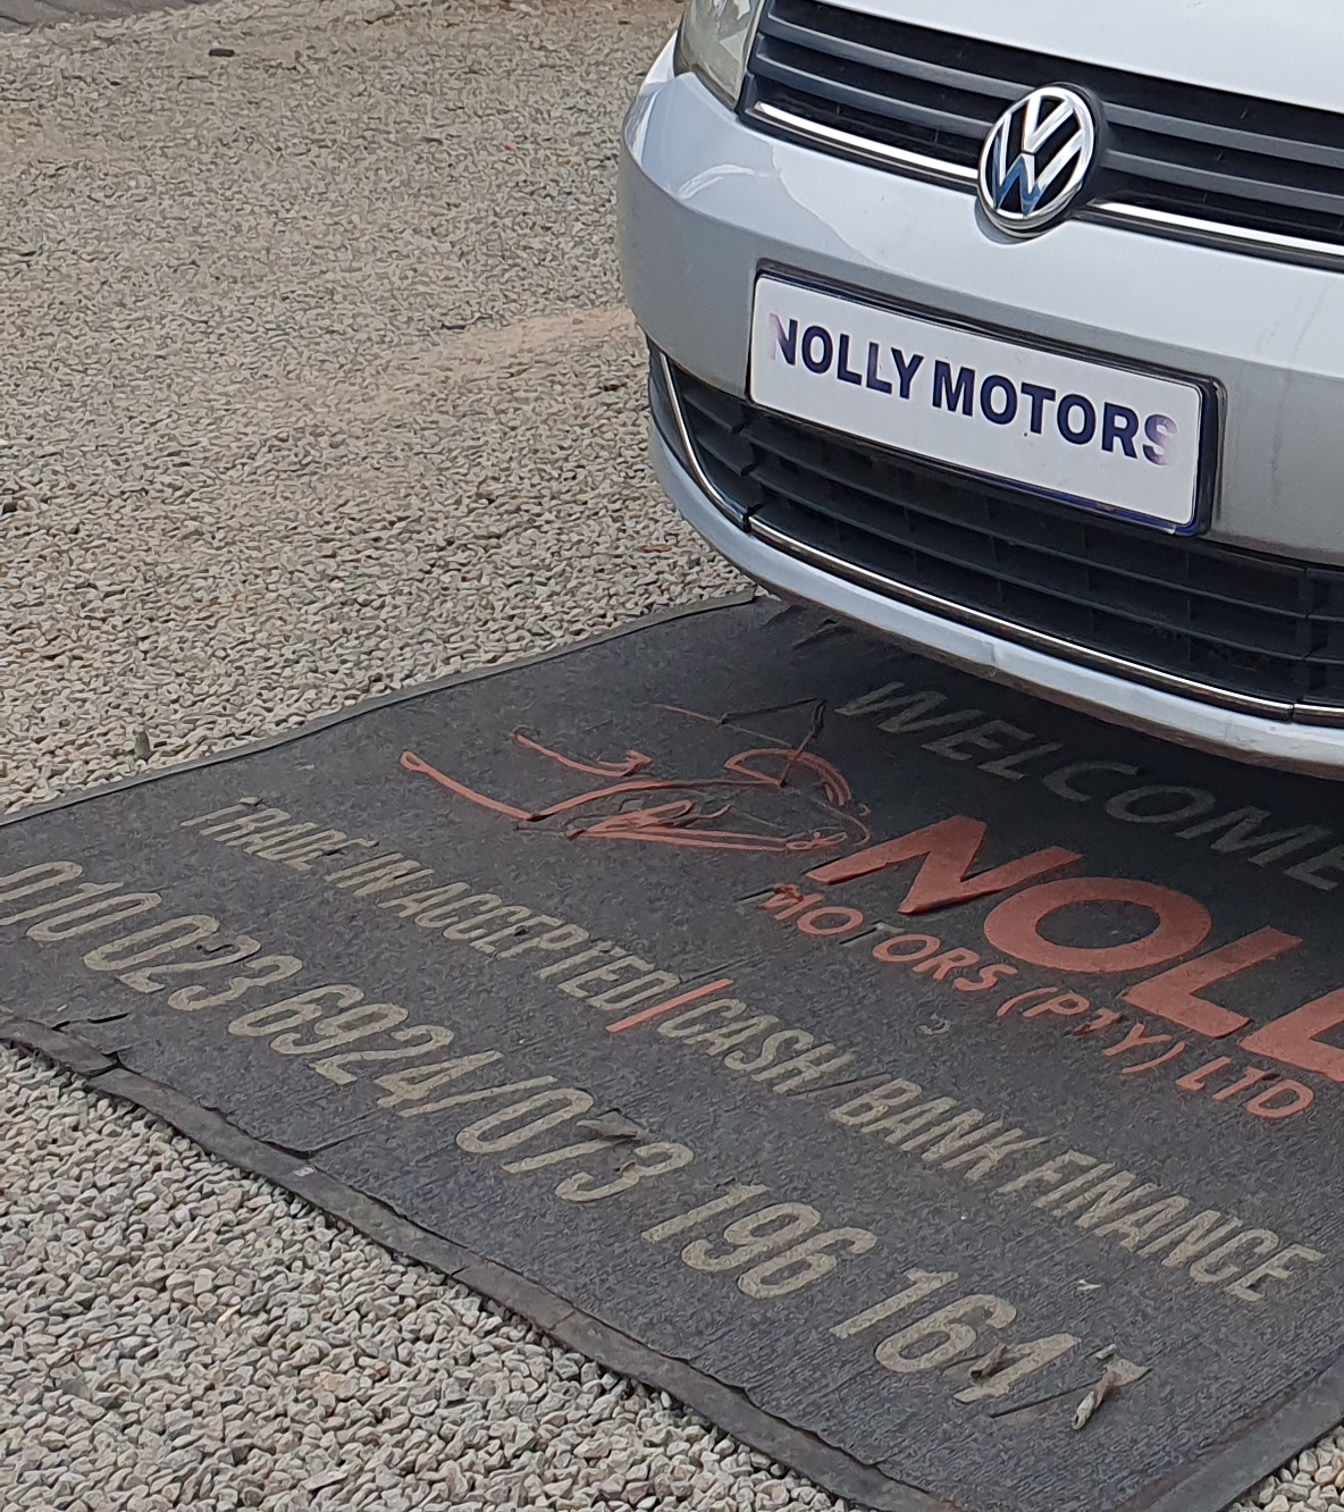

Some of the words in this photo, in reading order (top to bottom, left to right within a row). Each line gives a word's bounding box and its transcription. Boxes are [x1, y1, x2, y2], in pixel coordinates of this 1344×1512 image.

[769, 313, 924, 400] NOLLY
[931, 360, 1178, 467] MOTORS
[83, 914, 304, 1012] 023
[641, 1182, 878, 1299] 196
[179, 796, 380, 871] TRADE
[323, 852, 436, 897] IN
[998, 1149, 1327, 1303] FINANCE
[758, 883, 1019, 992] MOTORS
[1175, 1055, 1316, 1119] LTD
